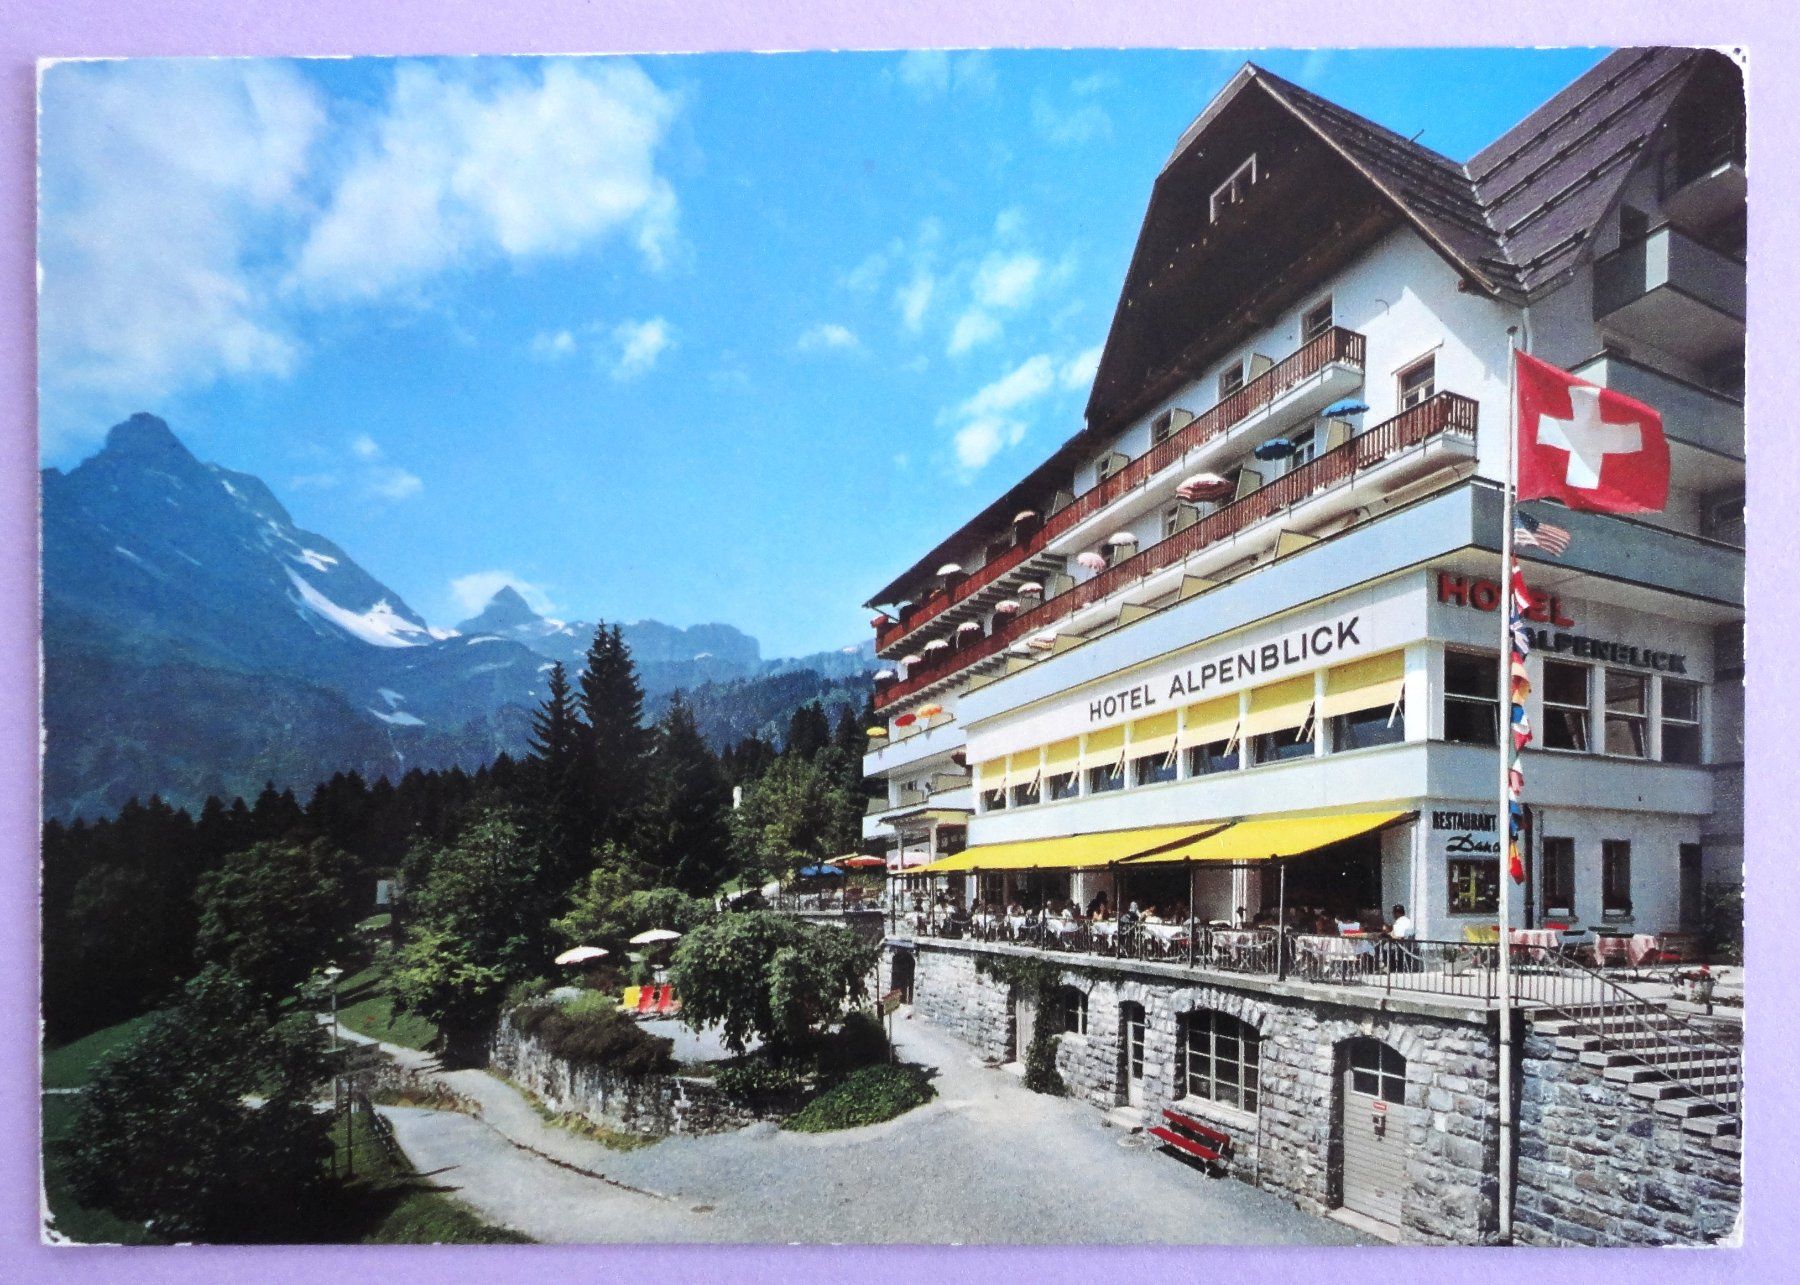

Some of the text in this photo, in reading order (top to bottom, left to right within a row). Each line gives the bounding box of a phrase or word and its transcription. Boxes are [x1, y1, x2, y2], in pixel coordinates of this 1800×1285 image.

[1437, 571, 1575, 628] HOEL
[1089, 616, 1361, 722] HOTEL ALPENBLICK
[1432, 810, 1497, 832] RESTAURANT
